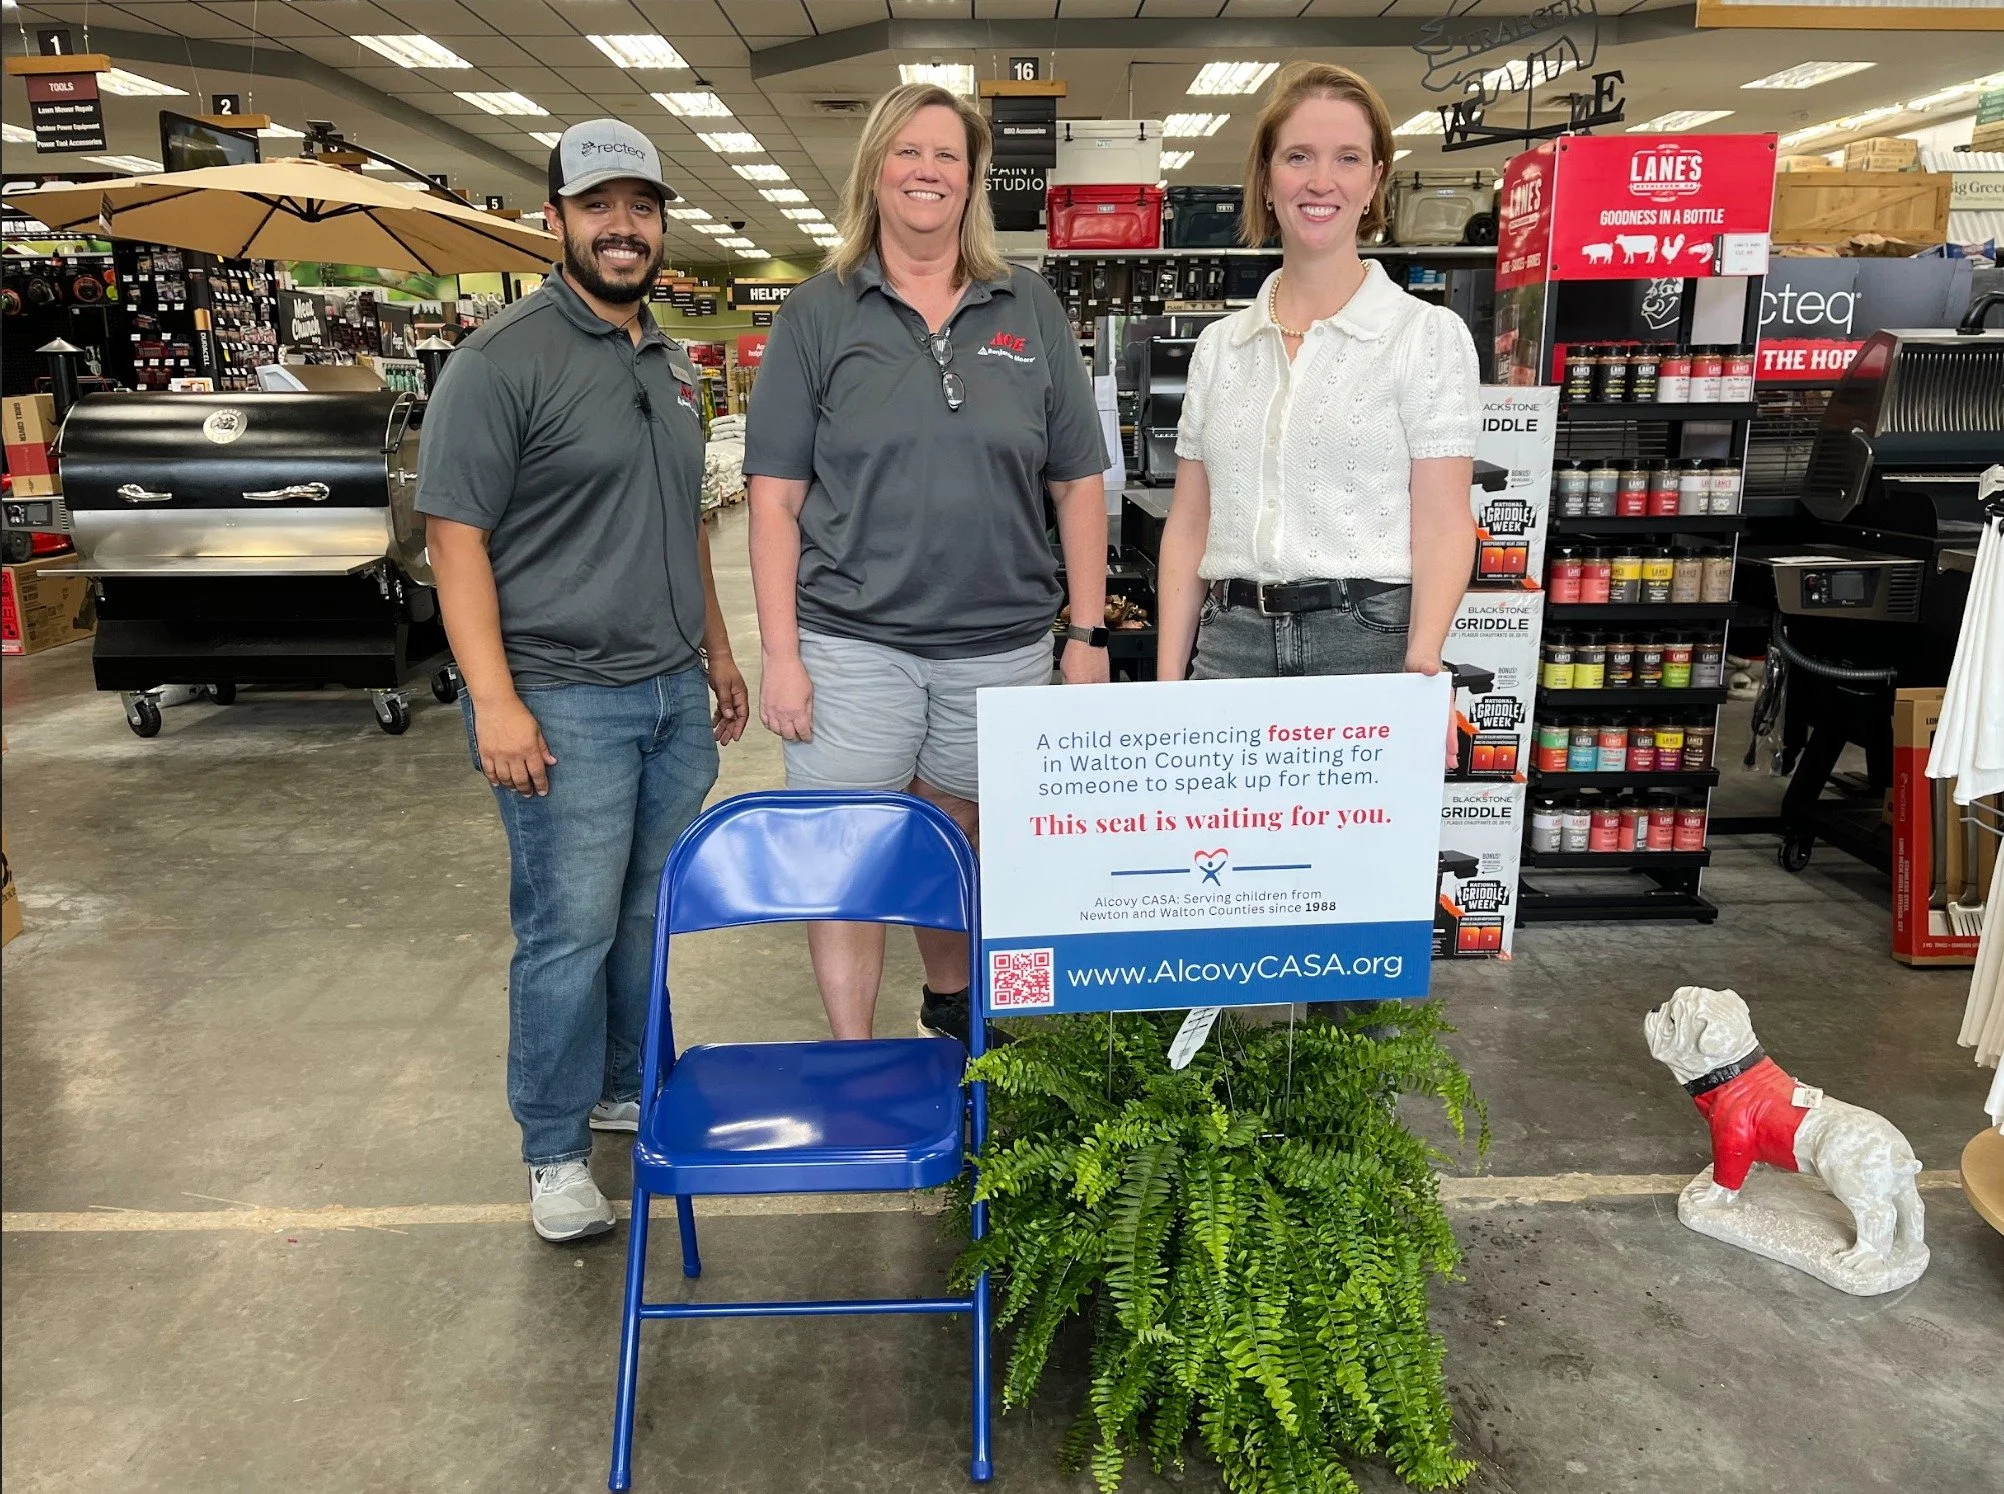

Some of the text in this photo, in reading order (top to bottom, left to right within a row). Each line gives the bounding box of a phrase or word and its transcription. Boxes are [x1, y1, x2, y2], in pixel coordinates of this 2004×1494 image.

[50, 35, 61, 55] 1
[1014, 62, 1034, 80] 16
[49, 82, 74, 91] TOOLS
[38, 104, 94, 114] Lawn Mower Repair
[220, 98, 231, 115] 2
[73, 122, 100, 132] Equipment
[1630, 155, 1703, 181] LANE'S
[984, 178, 1044, 191] STUDIO
[492, 199, 499, 210] 5
[1600, 208, 1724, 225] GOODNESS IN A BOTTLE
[293, 298, 314, 318] Meat
[291, 316, 321, 340] Church
[200, 332, 210, 366] DURACELL
[1762, 350, 1807, 370] THE
[13, 402, 23, 419] GRILL
[1483, 404, 1540, 412] ACKSTONE
[17, 421, 27, 442] COVER
[1483, 418, 1538, 431] IDDLE
[1486, 507, 1529, 523] GRIDDLE
[1493, 521, 1522, 532] WEEK
[1455, 618, 1529, 630] GRIDDLE
[1477, 704, 1519, 718] GRIDDLE
[1483, 717, 1511, 727] WEEK
[1036, 725, 1390, 750] A child experiencing foster care
[1043, 745, 1383, 772] in Walton County is waiting for
[1039, 769, 1378, 796] someone to speak up for them.
[1029, 805, 1391, 836] This seat is waiting for you.
[1441, 807, 1512, 818] GRIDDLE
[1095, 889, 1322, 908] Alcovy CASA: Serving children from
[1463, 888, 1503, 901] GRIDDLE
[1080, 901, 1337, 921] Newton and Walton Counties since 1988
[1469, 900, 1495, 909] WEEK
[1067, 952, 1403, 987] www.AlcovyCASA.org
